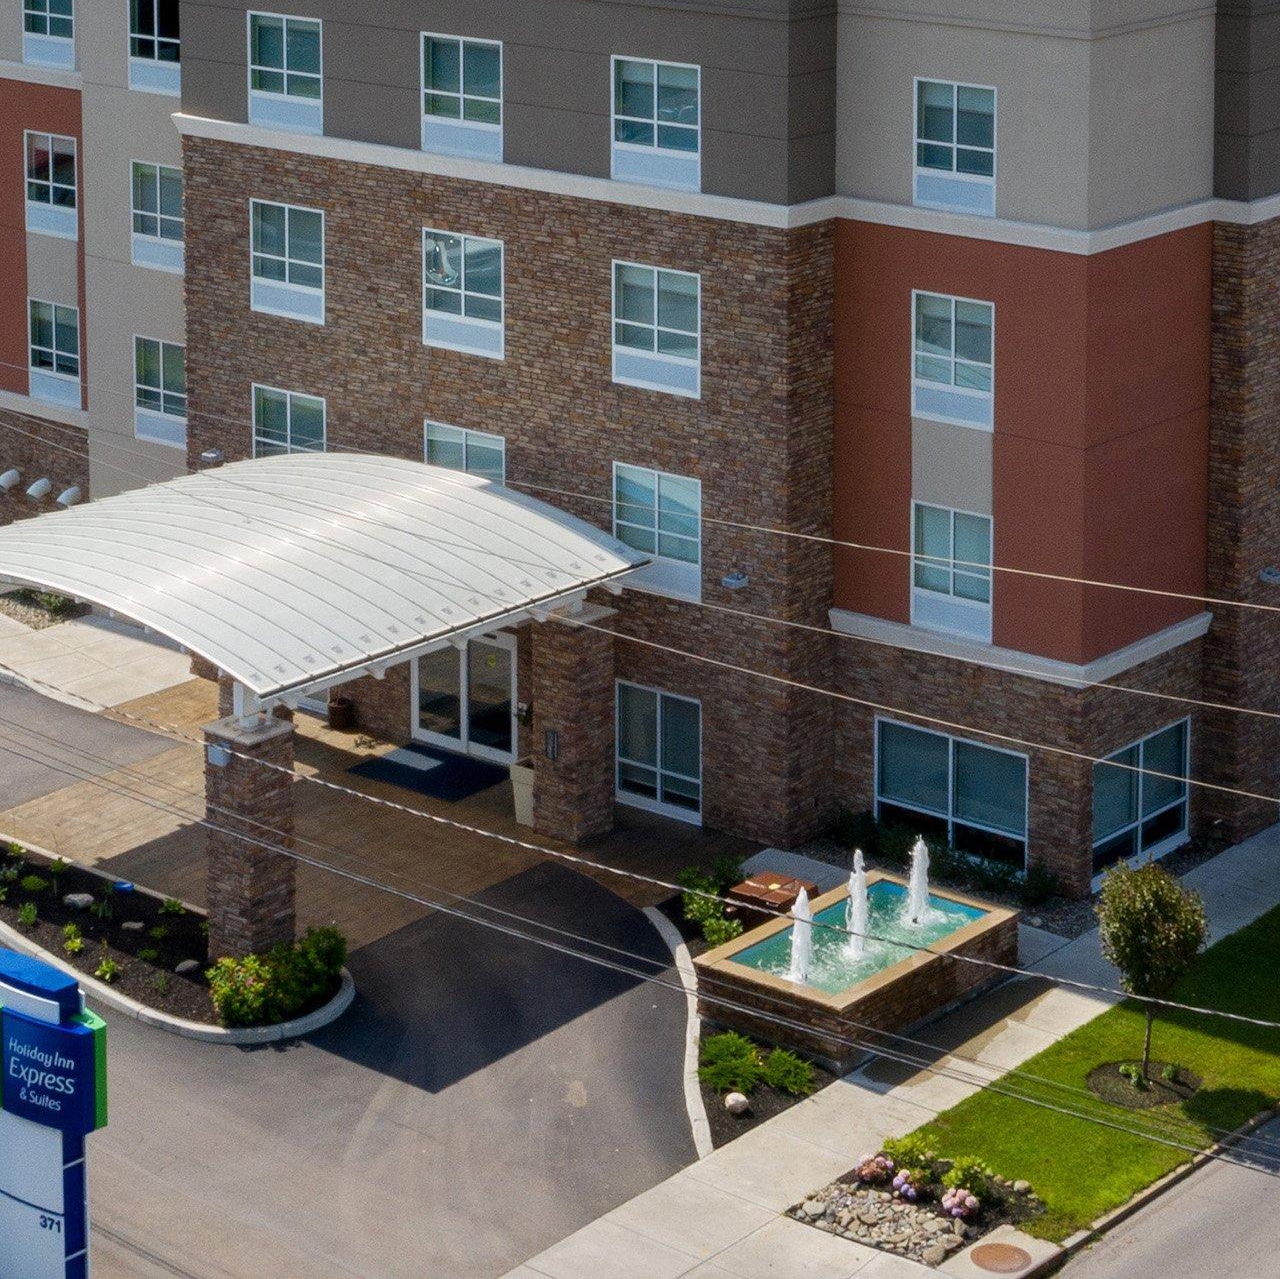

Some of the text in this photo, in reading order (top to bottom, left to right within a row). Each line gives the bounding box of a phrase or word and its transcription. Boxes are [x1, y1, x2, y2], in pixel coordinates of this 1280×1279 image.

[9, 1038, 75, 1070] Holiday Inn
[9, 1057, 75, 1095] Express
[19, 1087, 62, 1112] & Suites
[40, 1215, 61, 1233] 371
